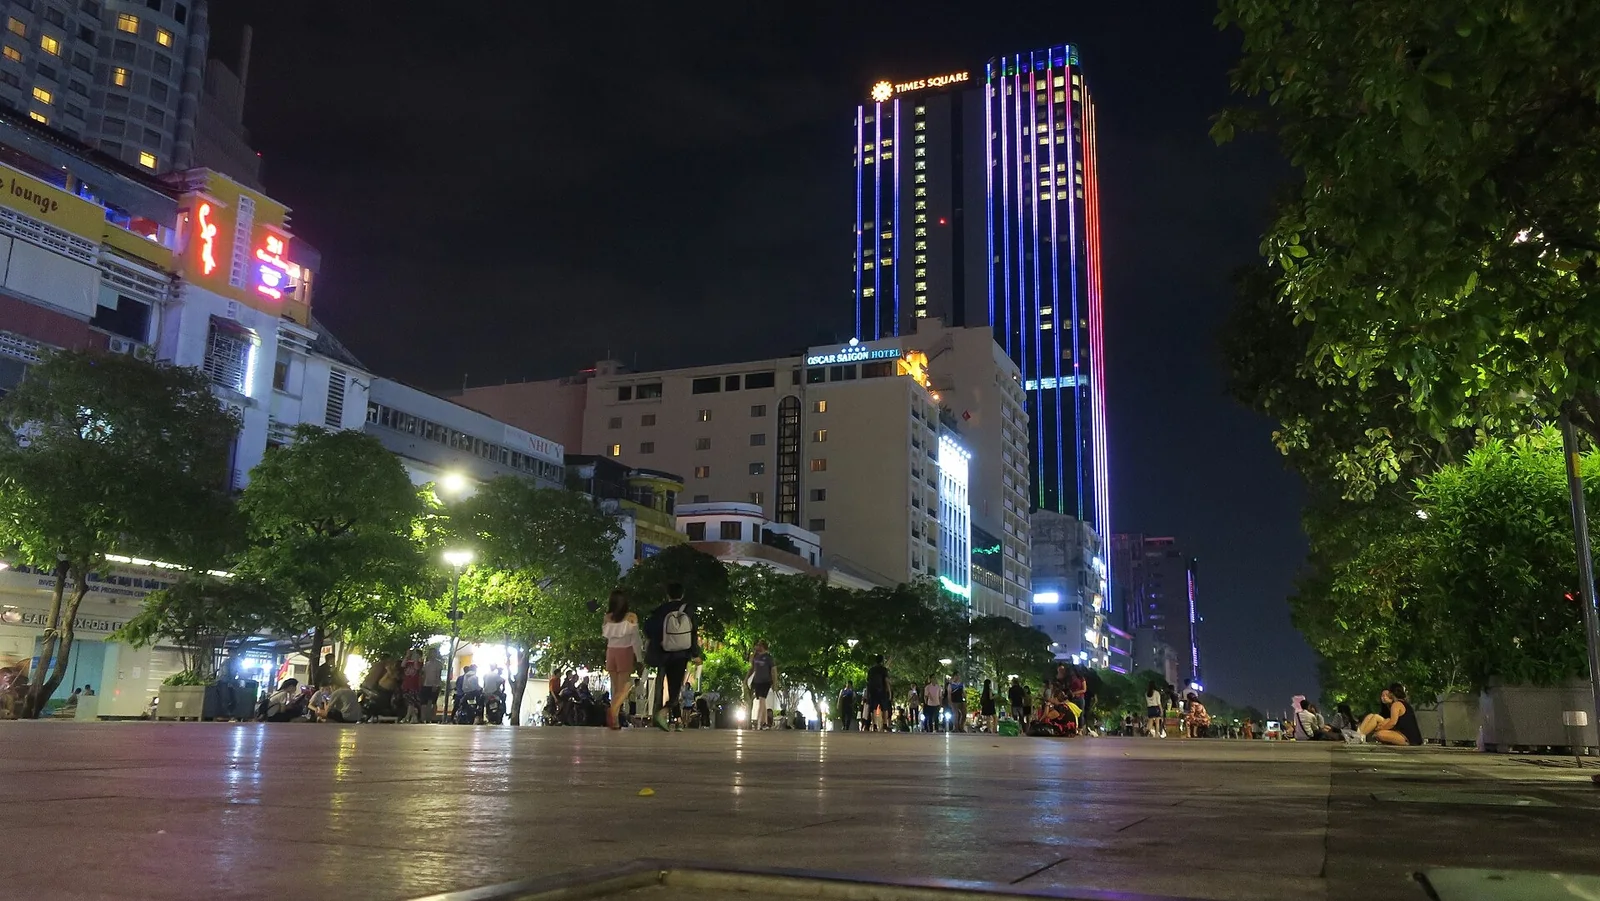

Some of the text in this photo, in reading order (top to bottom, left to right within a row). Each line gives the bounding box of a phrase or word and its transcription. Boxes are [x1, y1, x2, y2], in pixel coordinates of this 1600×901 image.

[895, 71, 969, 93] TIMES SQUARE
[10, 178, 59, 214] lounge
[807, 349, 901, 365] OSCAR SAIGON HOTEL
